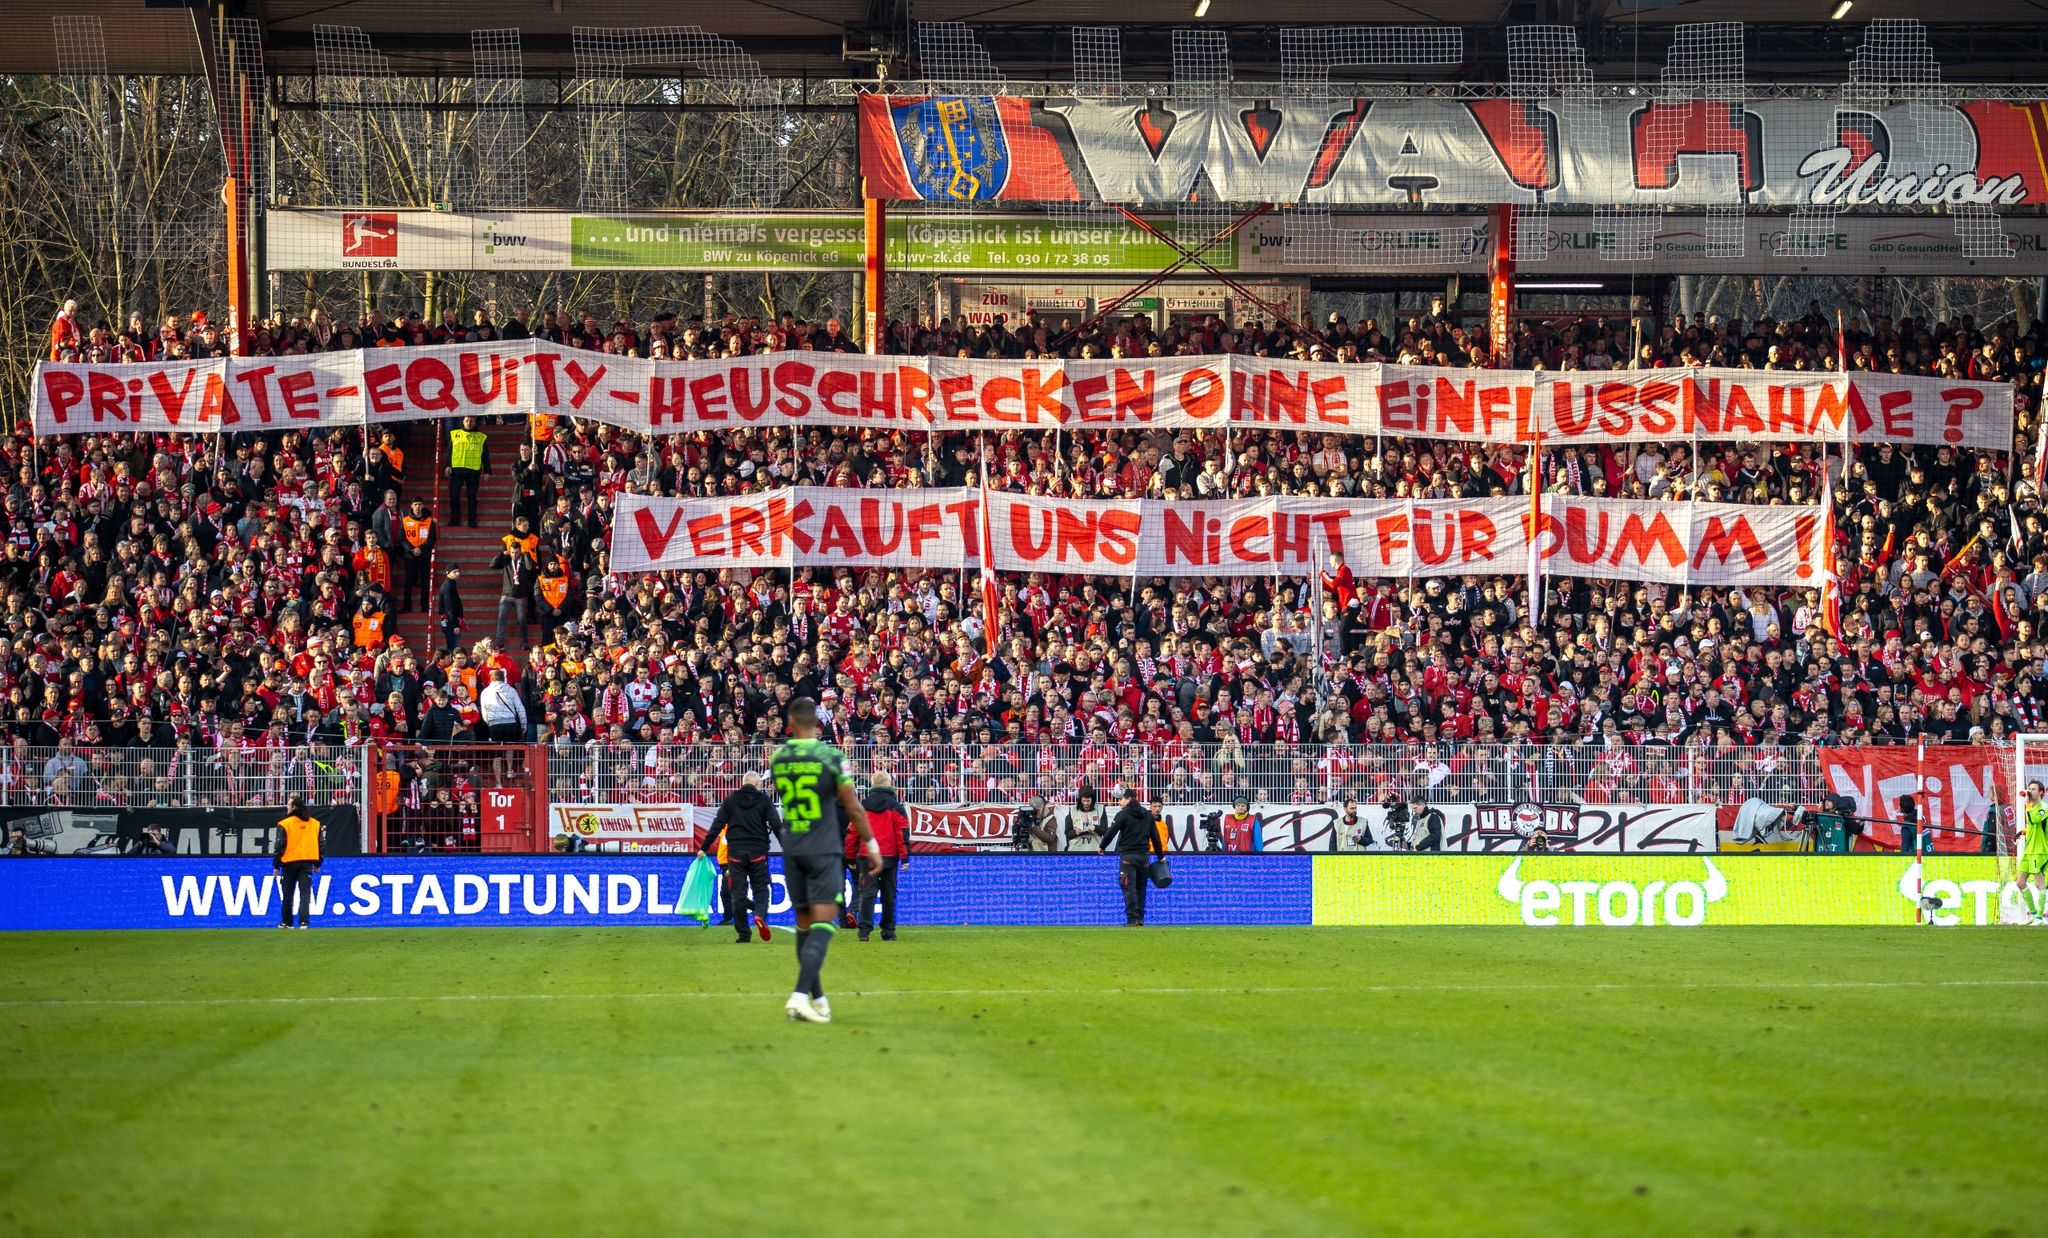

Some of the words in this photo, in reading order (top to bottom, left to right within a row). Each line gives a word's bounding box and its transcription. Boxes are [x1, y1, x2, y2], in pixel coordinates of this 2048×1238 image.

[1799, 146, 2028, 205] Union
[493, 232, 527, 247] bwv
[678, 222, 767, 243] niemals
[906, 224, 1008, 249] Köpenick
[1015, 224, 1042, 244] ist
[1050, 228, 1112, 245] unser
[1259, 232, 1293, 247] bwv
[1869, 243, 1894, 253] GHD
[703, 250, 732, 263] BWV
[736, 253, 752, 263] zu
[756, 249, 818, 266] Köpenick
[822, 251, 839, 263] eG
[987, 251, 1010, 264] Tel.
[1015, 253, 1041, 265] 030
[1054, 253, 1069, 265] 72
[1073, 251, 1089, 265] 38
[1093, 252, 1110, 265] 05
[1178, 367, 1350, 425] OHNE
[1940, 387, 1985, 444] ?
[634, 497, 981, 561] VERKAUFT
[1009, 503, 1142, 565] UNS
[1376, 508, 1496, 565] FÜR
[1794, 514, 1816, 579] !
[488, 791, 515, 807] Tor
[775, 774, 822, 820] 25
[495, 814, 505, 831] 1
[599, 817, 634, 832] UNION
[632, 807, 686, 832] FANCLUB
[1479, 809, 1513, 831] UB
[1545, 808, 1576, 831] DK
[622, 841, 689, 853] Brgerbräu
[1080, 836, 1092, 844] TV
